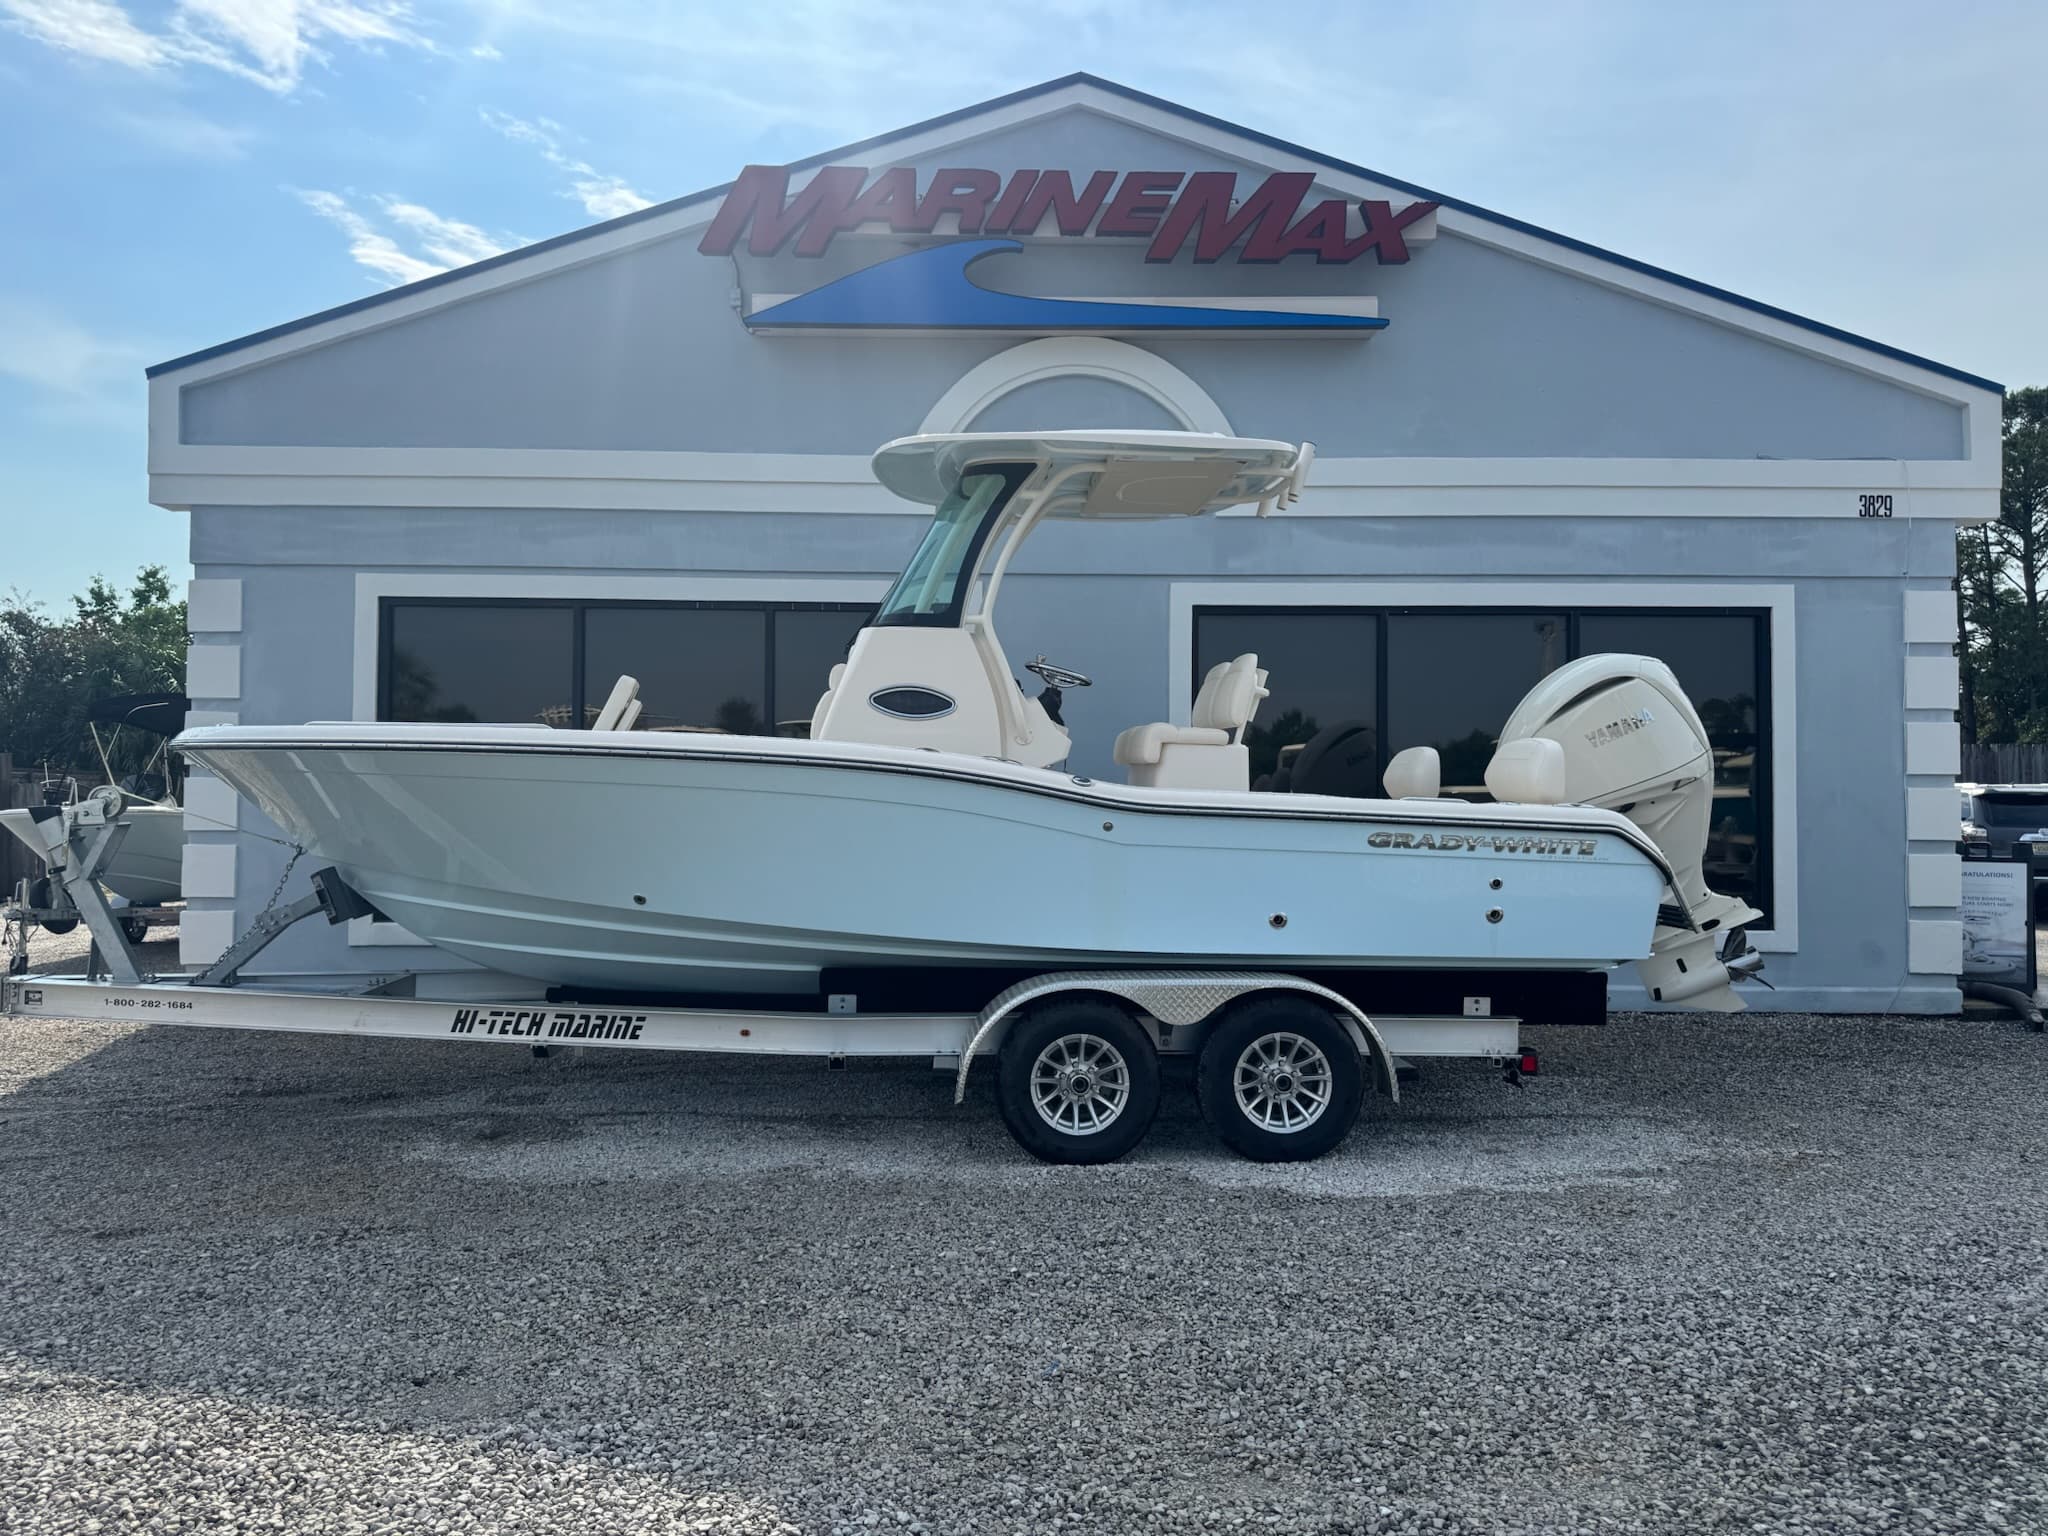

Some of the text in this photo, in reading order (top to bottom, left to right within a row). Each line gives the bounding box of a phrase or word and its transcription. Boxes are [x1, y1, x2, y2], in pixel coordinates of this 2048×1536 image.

[1859, 494, 1893, 518] 3829
[1584, 707, 1655, 748] YAMAHA
[1367, 831, 1598, 856] GRADY-WHITE
[103, 998, 193, 1010] 1-800-282-1684
[450, 1009, 647, 1040] HI-TECH MARINE
